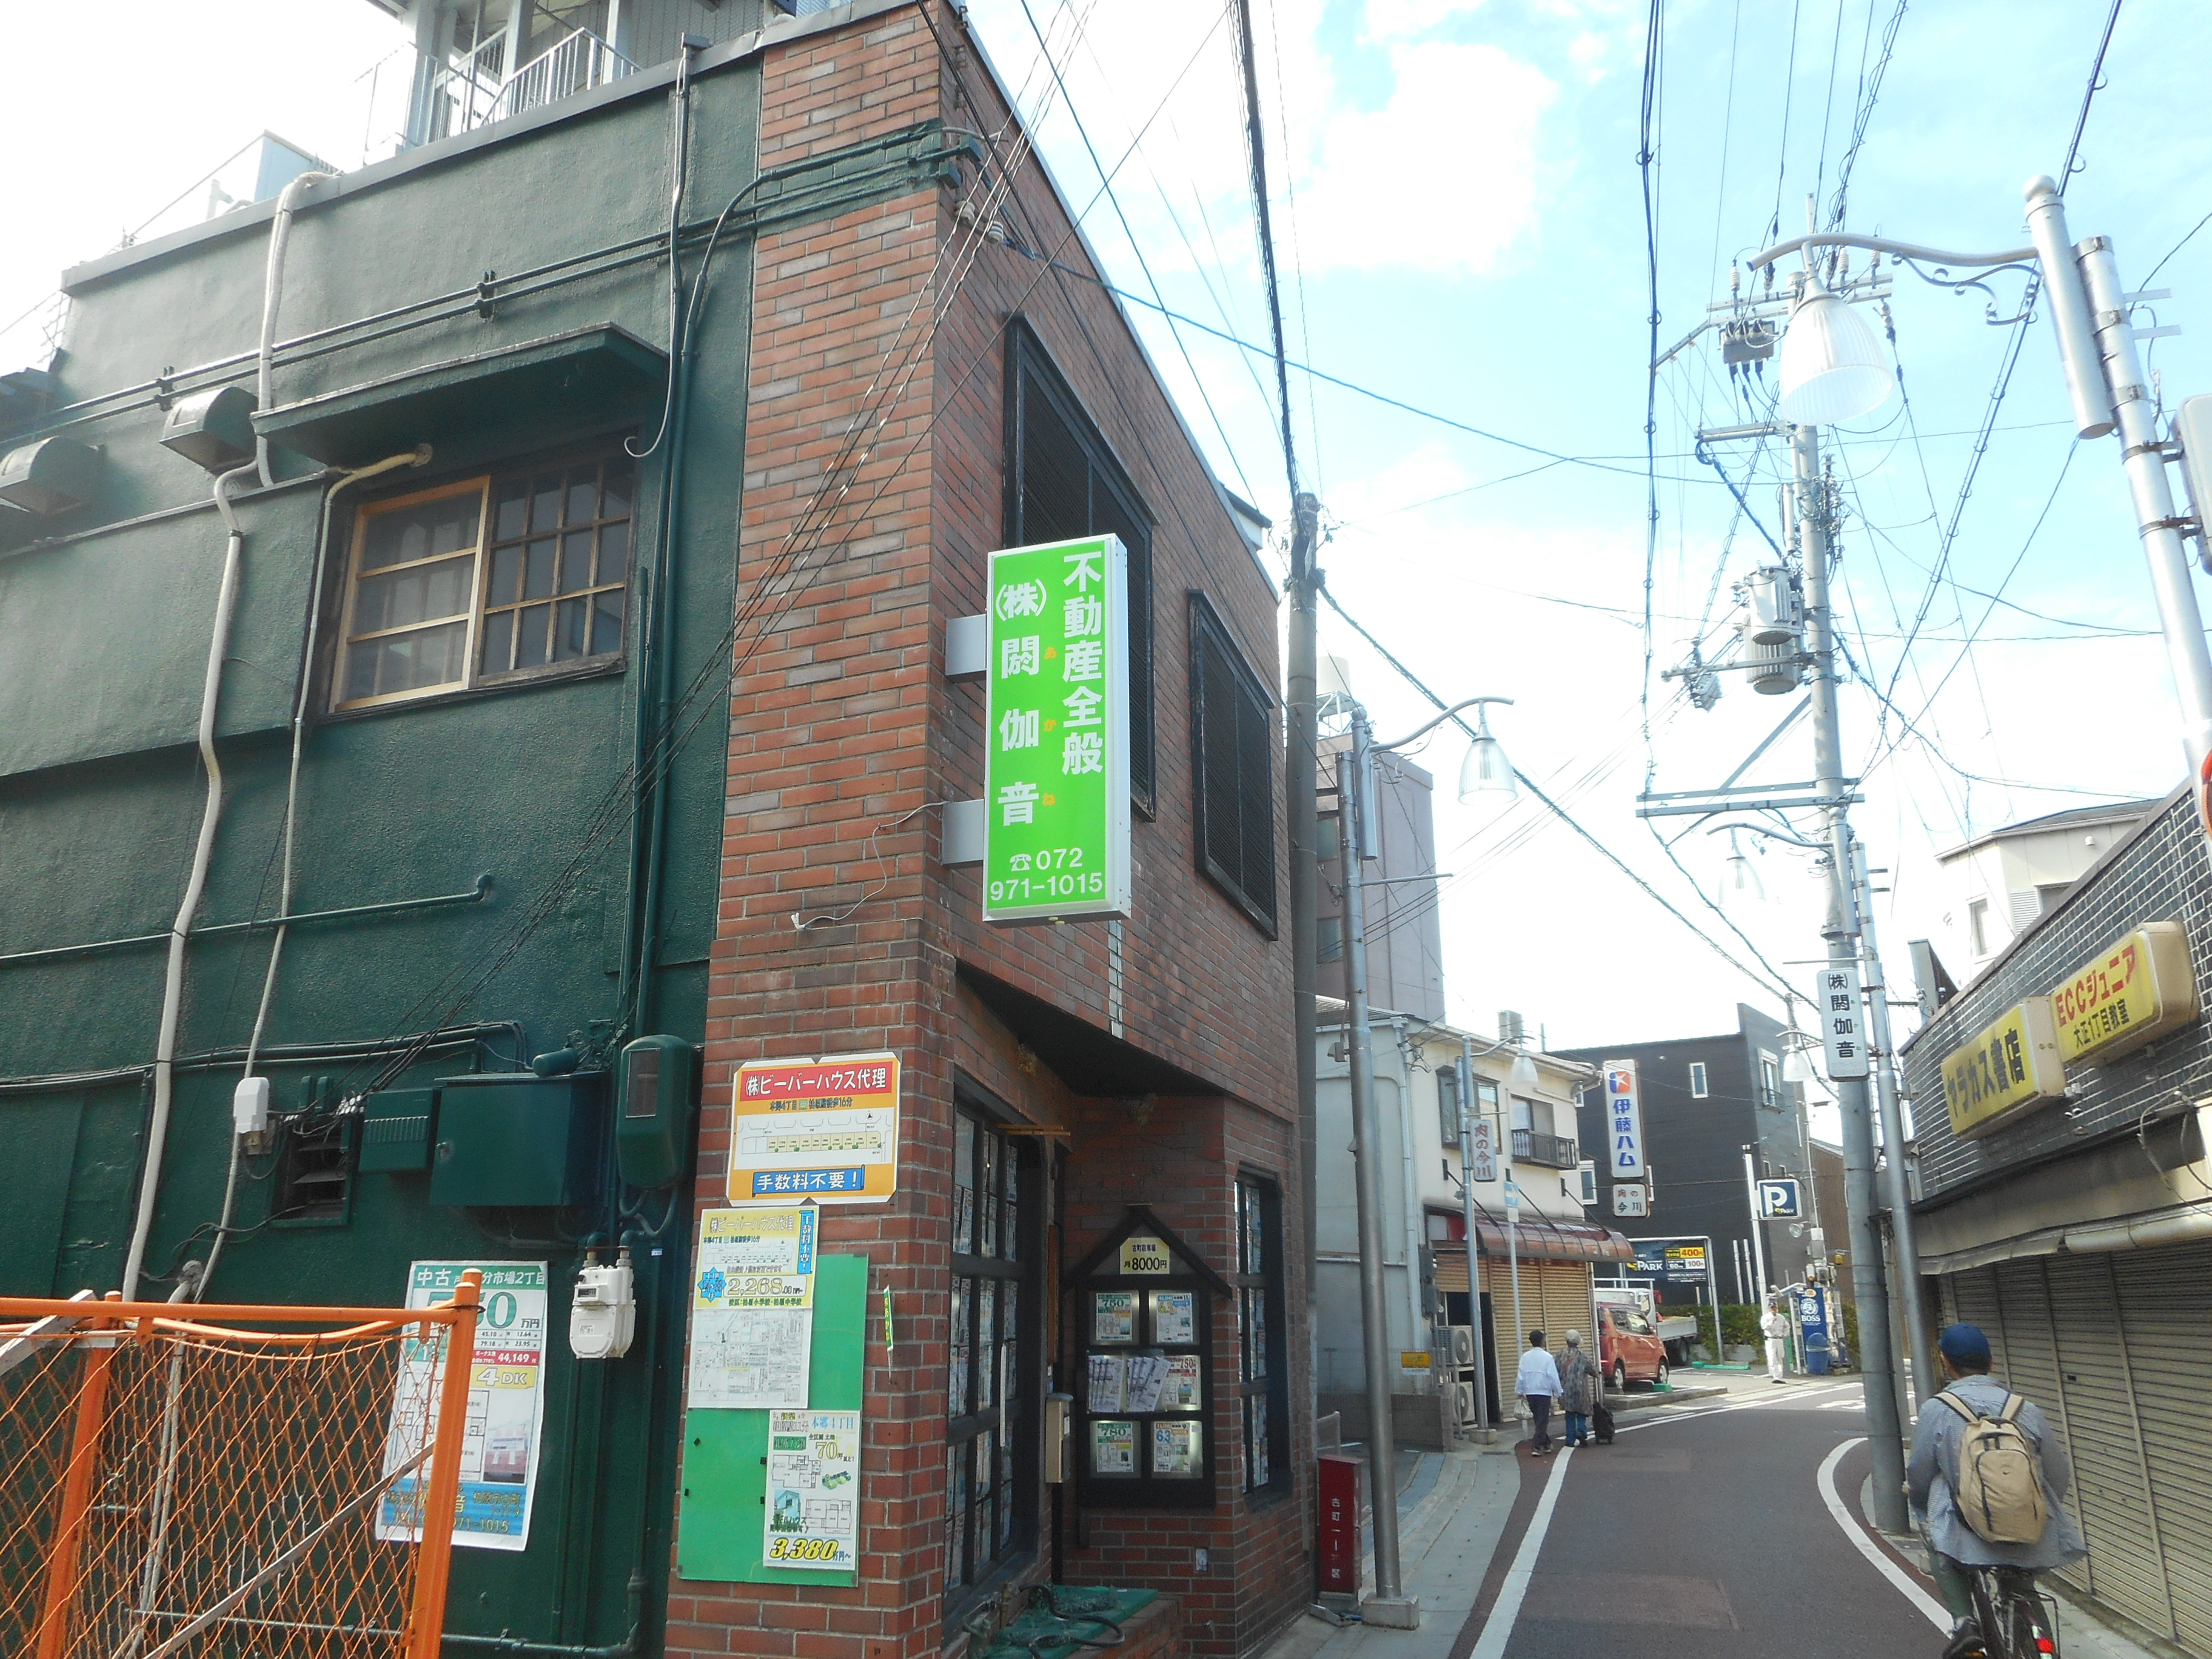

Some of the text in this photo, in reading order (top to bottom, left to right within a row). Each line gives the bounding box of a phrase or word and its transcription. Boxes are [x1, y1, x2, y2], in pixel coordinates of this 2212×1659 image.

[1062, 550, 1103, 776] 不動産全般
[1035, 847, 1084, 871] 072
[990, 872, 1103, 901] 971-1015
[2055, 942, 2136, 1027] ECCジュニア
[2074, 997, 2130, 1049] 大正1丁目教室
[1613, 1098, 1636, 1167] 伊藤ハム
[1473, 1123, 1491, 1178] 肉の今川
[1617, 1188, 1639, 1198] 肉の
[1763, 1184, 1788, 1215] P
[1617, 1201, 1643, 1213] 今川
[1131, 1244, 1156, 1252] 古町駐車場
[1123, 1257, 1167, 1271] 月8000円
[417, 1267, 452, 1287] 中古
[481, 1271, 546, 1285] 分市場2丁目
[498, 1352, 530, 1364] 44,149
[477, 1367, 528, 1387] 4DK
